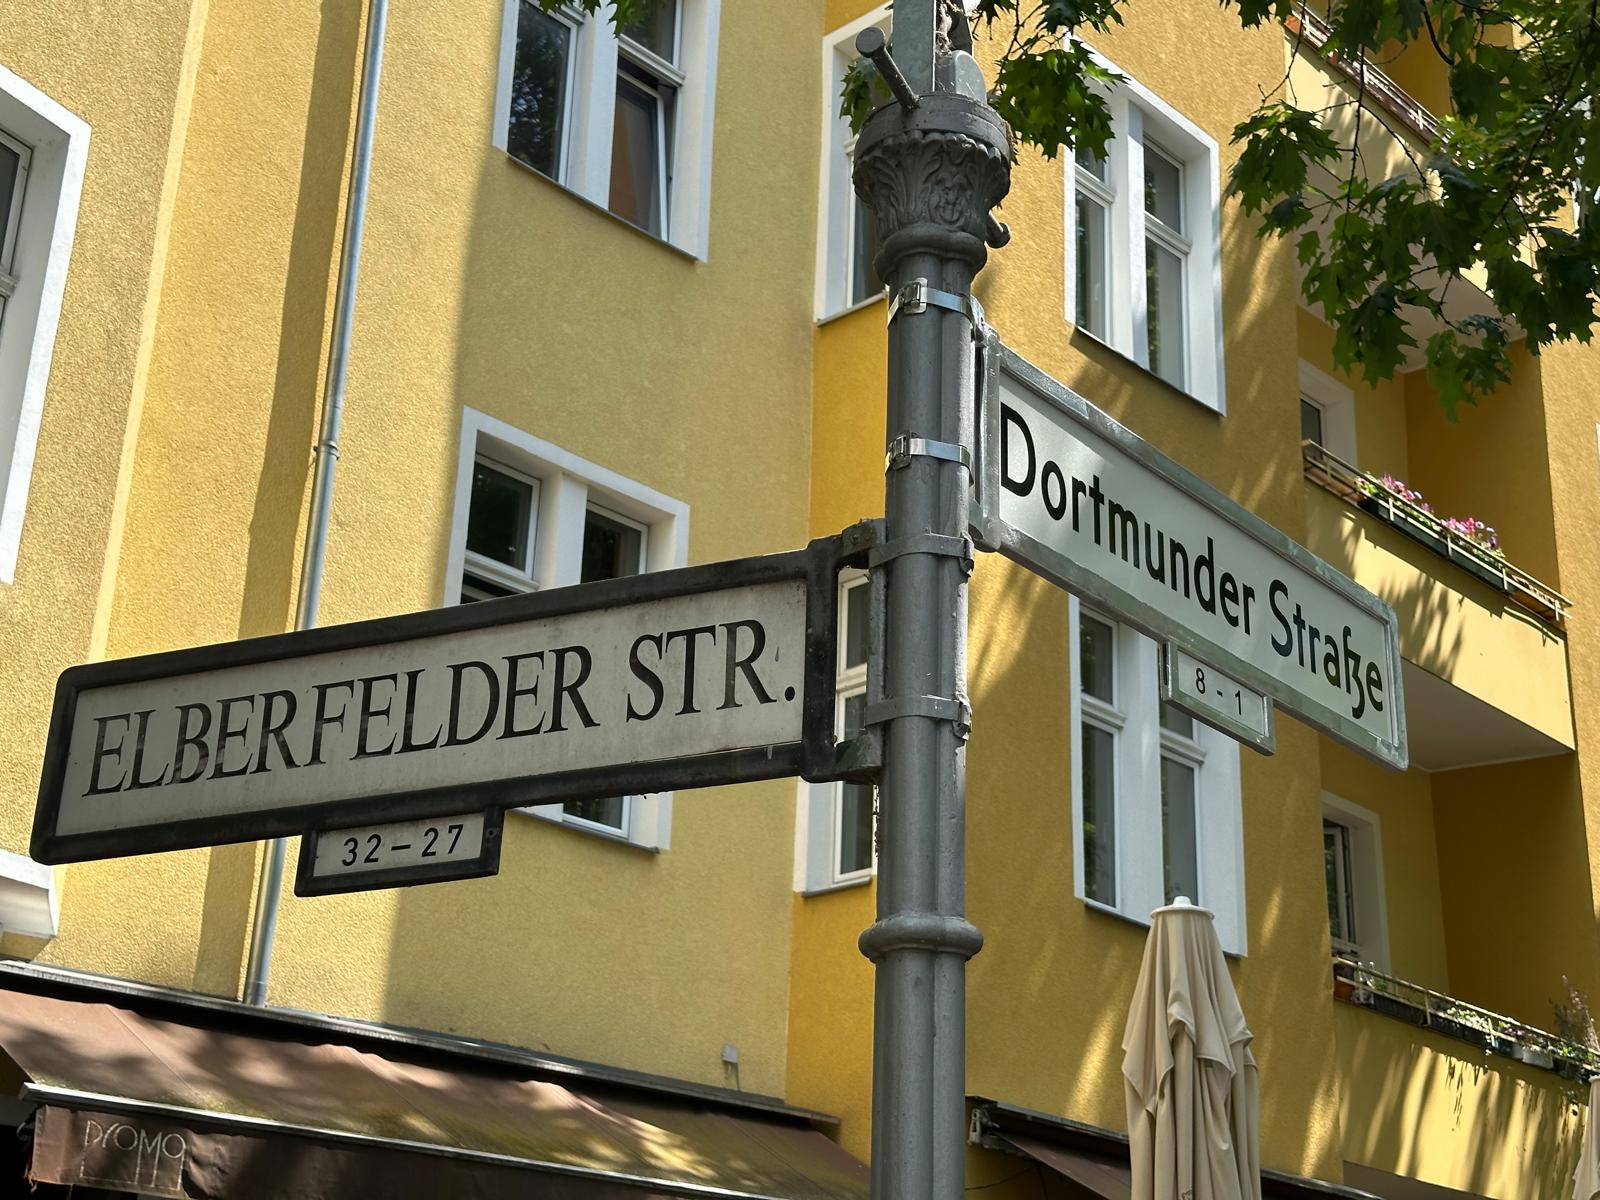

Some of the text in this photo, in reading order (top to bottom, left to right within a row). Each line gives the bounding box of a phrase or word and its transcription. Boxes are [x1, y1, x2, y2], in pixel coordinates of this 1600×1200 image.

[1000, 402, 1384, 720] Dortmunder Straße
[82, 619, 796, 797] ELBERFELDER STR.
